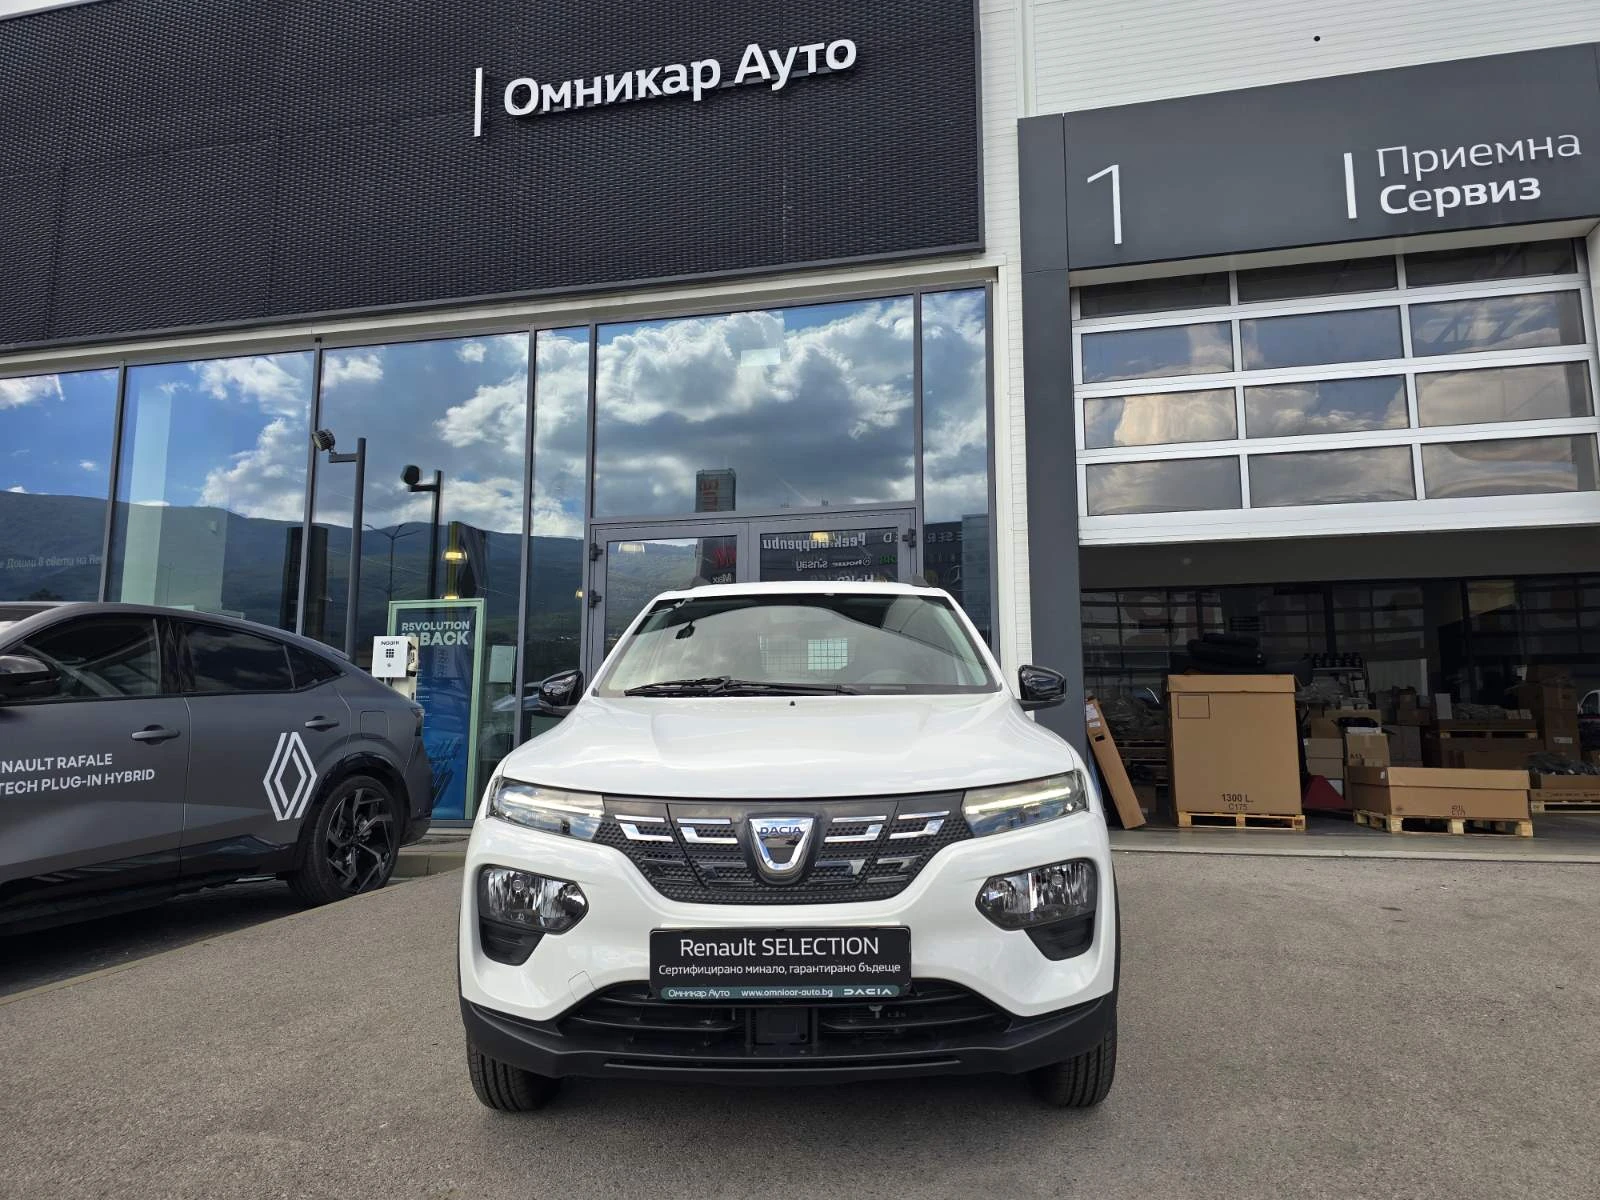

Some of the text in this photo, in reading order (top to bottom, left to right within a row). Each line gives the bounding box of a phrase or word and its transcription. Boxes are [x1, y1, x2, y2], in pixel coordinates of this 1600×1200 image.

[504, 39, 857, 116] Омникар Ауто
[1376, 134, 1582, 181] Приемна
[1087, 164, 1122, 245] 1
[1380, 177, 1541, 217] Сервиз
[401, 621, 470, 631] R5VOLUTION
[420, 631, 471, 646] BACK
[0, 753, 113, 773] NAULT RAFALE
[0, 769, 155, 795] TECH PLUG-IN HYBRID
[1222, 793, 1242, 802] 1300
[760, 826, 801, 834] DACIA
[680, 936, 879, 956] Renault SELECTION
[659, 962, 901, 976] Сертифицирано минало, гарантирано бъдеще
[708, 989, 730, 998] Ауто
[843, 988, 892, 996] DACIA
